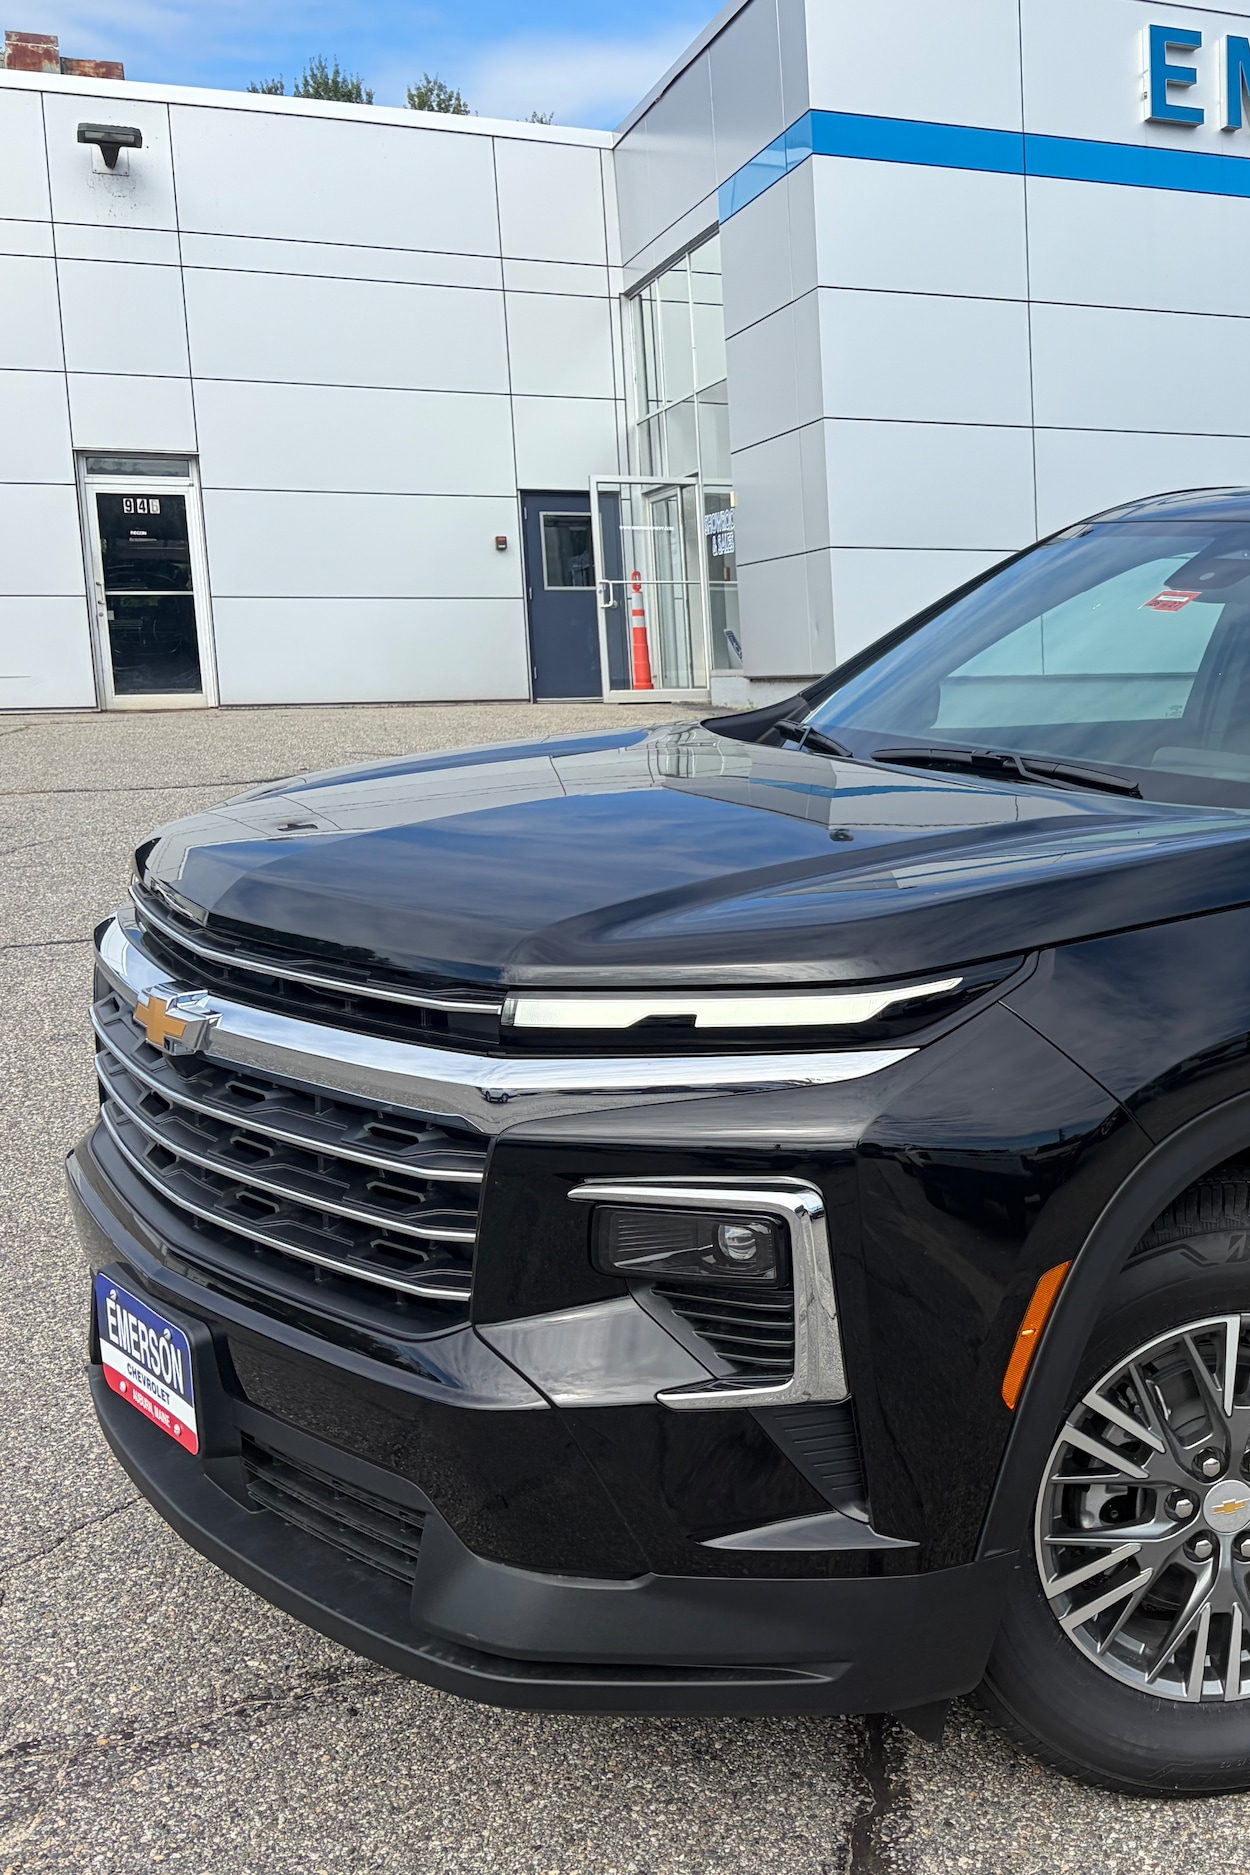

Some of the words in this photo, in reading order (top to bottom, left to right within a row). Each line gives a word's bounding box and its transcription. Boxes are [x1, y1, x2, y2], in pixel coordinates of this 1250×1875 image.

[704, 508, 736, 536] SHOWROO
[717, 532, 735, 556] SALES
[105, 1297, 185, 1395] EMERSON
[127, 1362, 170, 1406] CHEVROLET
